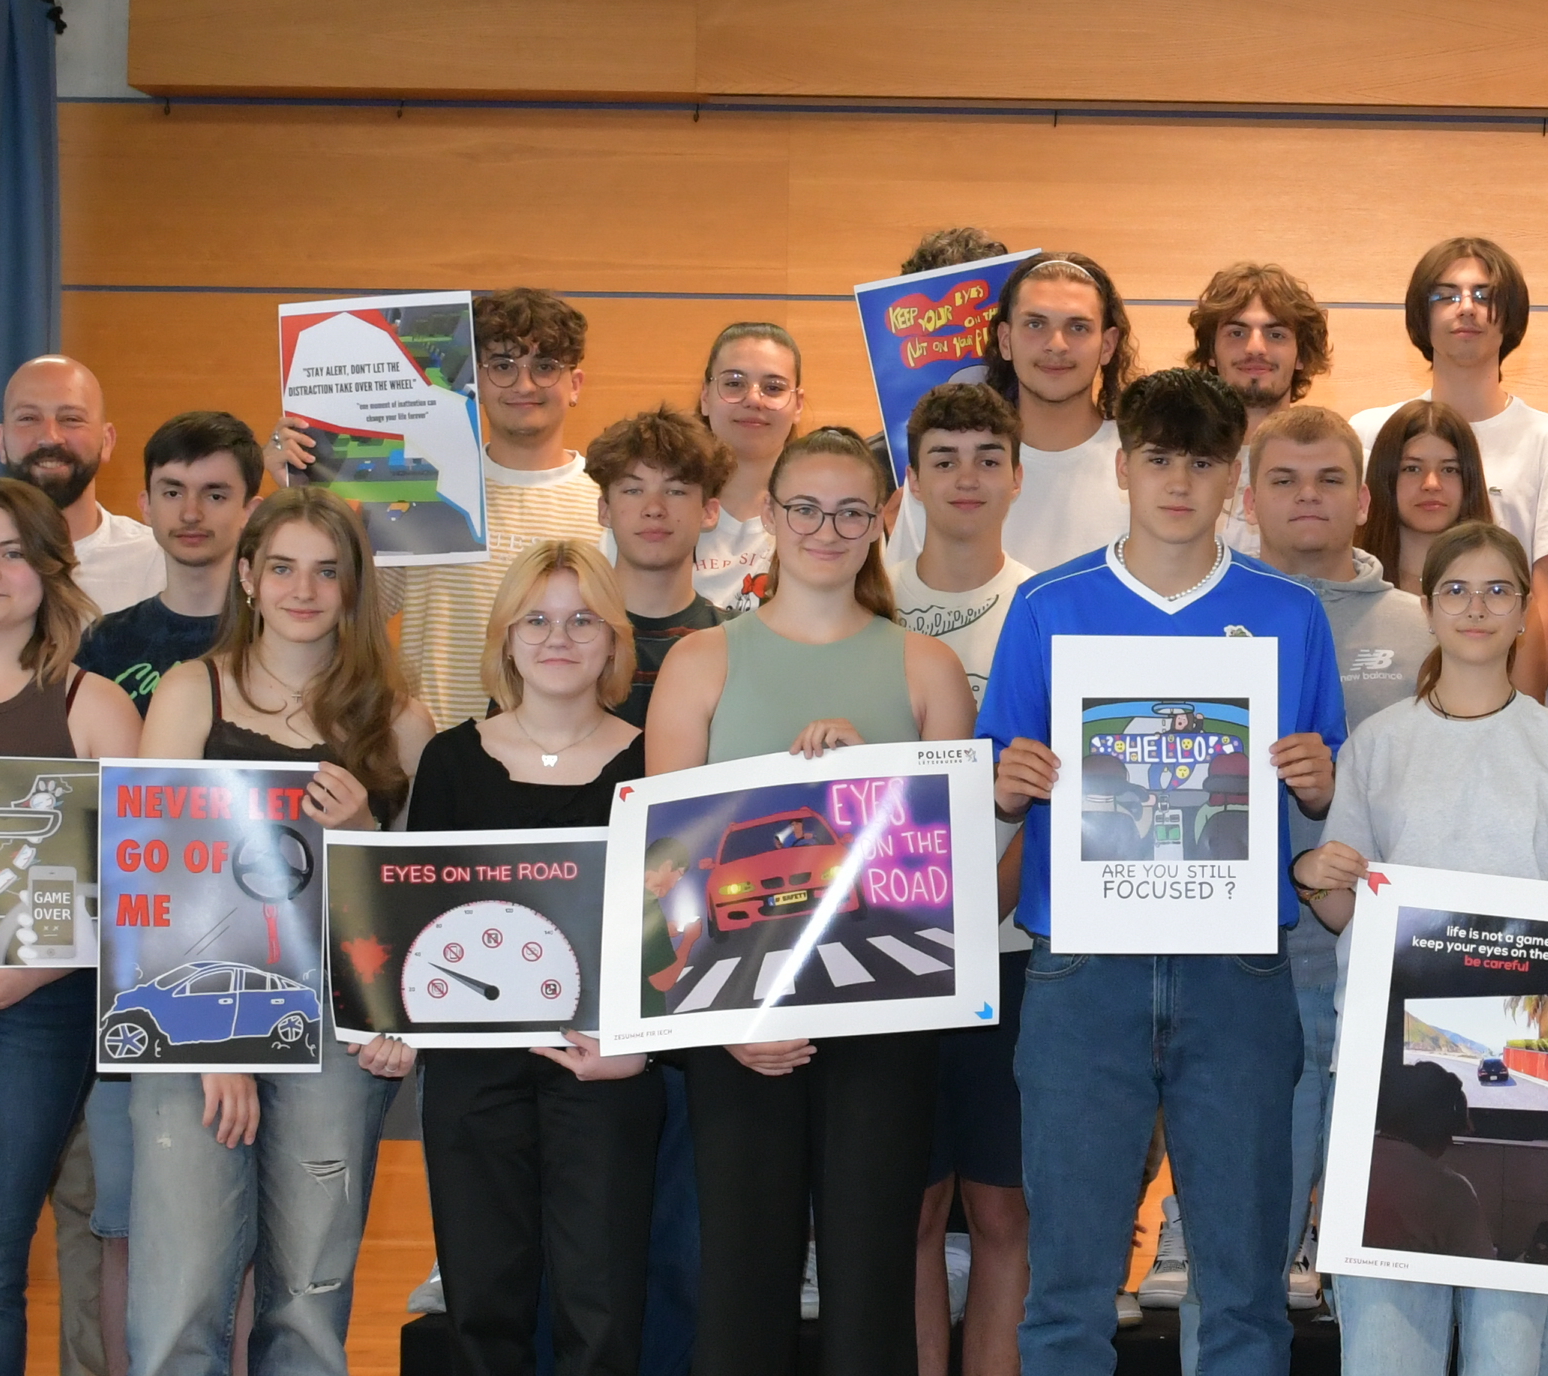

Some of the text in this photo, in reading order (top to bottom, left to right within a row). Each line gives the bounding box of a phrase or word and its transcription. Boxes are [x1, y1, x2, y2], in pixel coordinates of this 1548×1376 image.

[888, 285, 984, 334] KEEP YOUR EYES
[907, 337, 928, 367] NOT
[932, 340, 948, 353] ON
[350, 363, 372, 375] DON'T
[372, 362, 385, 374] LET
[387, 361, 400, 372] THE
[288, 383, 334, 397] DISTRACTION
[335, 382, 353, 393] TAKE
[354, 381, 373, 392] OVER
[374, 380, 388, 391] THE
[1362, 671, 1403, 680] balance
[918, 749, 962, 759] POLICE
[117, 784, 304, 821] NEVER LET
[832, 777, 906, 826] EYES
[901, 830, 947, 854] THE
[116, 838, 229, 874] GO OF
[381, 861, 579, 883] EYES ON THE ROAD
[1102, 864, 1237, 878] ARE YOU STILL
[868, 866, 947, 904] ROAD
[1103, 879, 1236, 900] FOCUSED ?
[34, 891, 71, 904] GAME
[33, 908, 72, 920] OVER
[115, 893, 171, 927] ME
[1446, 926, 1467, 938] life
[1468, 928, 1479, 939] is
[1481, 930, 1503, 942] not
[1505, 934, 1513, 943] a
[1411, 935, 1444, 952] keep
[1446, 941, 1476, 954] your
[1478, 944, 1509, 958] eyes
[1510, 948, 1527, 958] on
[1464, 954, 1530, 972] be careful
